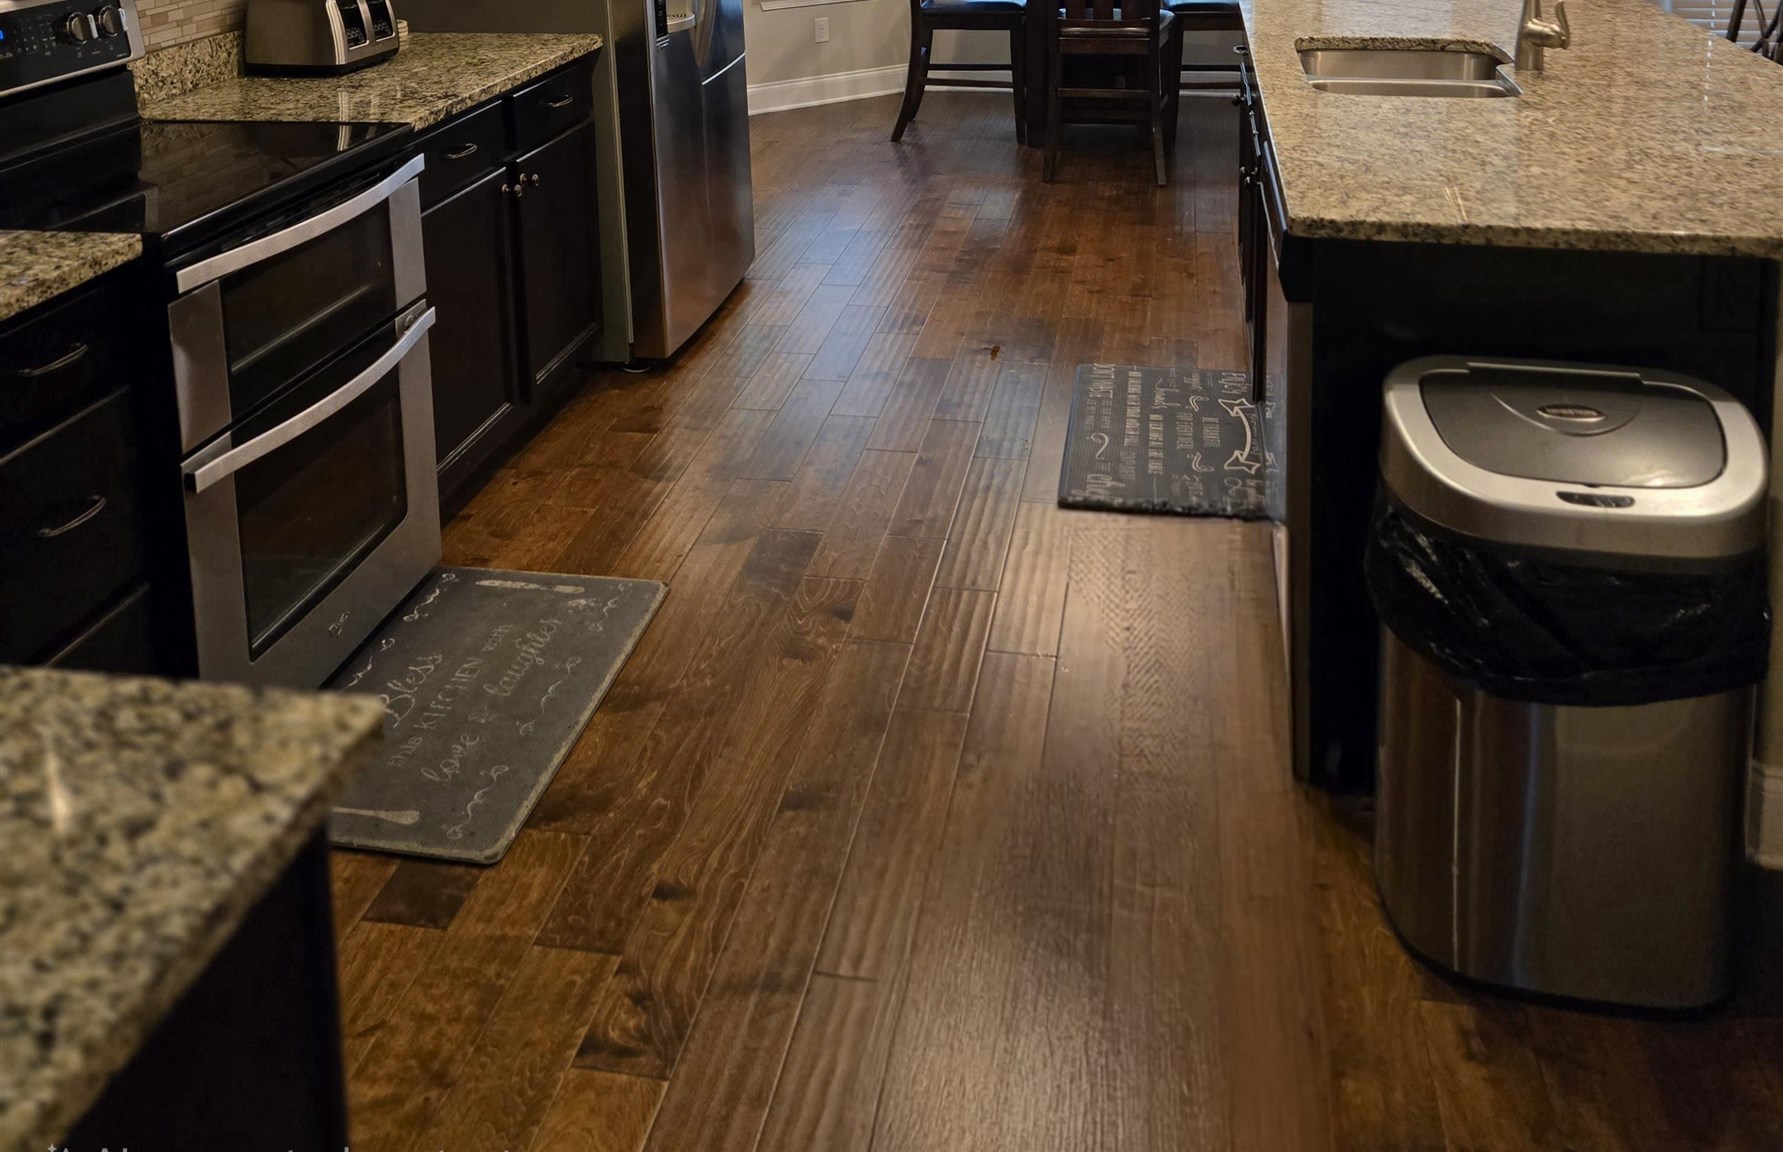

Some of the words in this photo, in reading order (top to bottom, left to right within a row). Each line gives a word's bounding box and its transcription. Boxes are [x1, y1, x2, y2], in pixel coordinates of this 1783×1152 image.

[372, 652, 443, 729] Bless
[387, 735, 423, 767] this
[413, 657, 486, 730] KITCHEN
[420, 734, 480, 782] love
[482, 618, 563, 696] laughter
